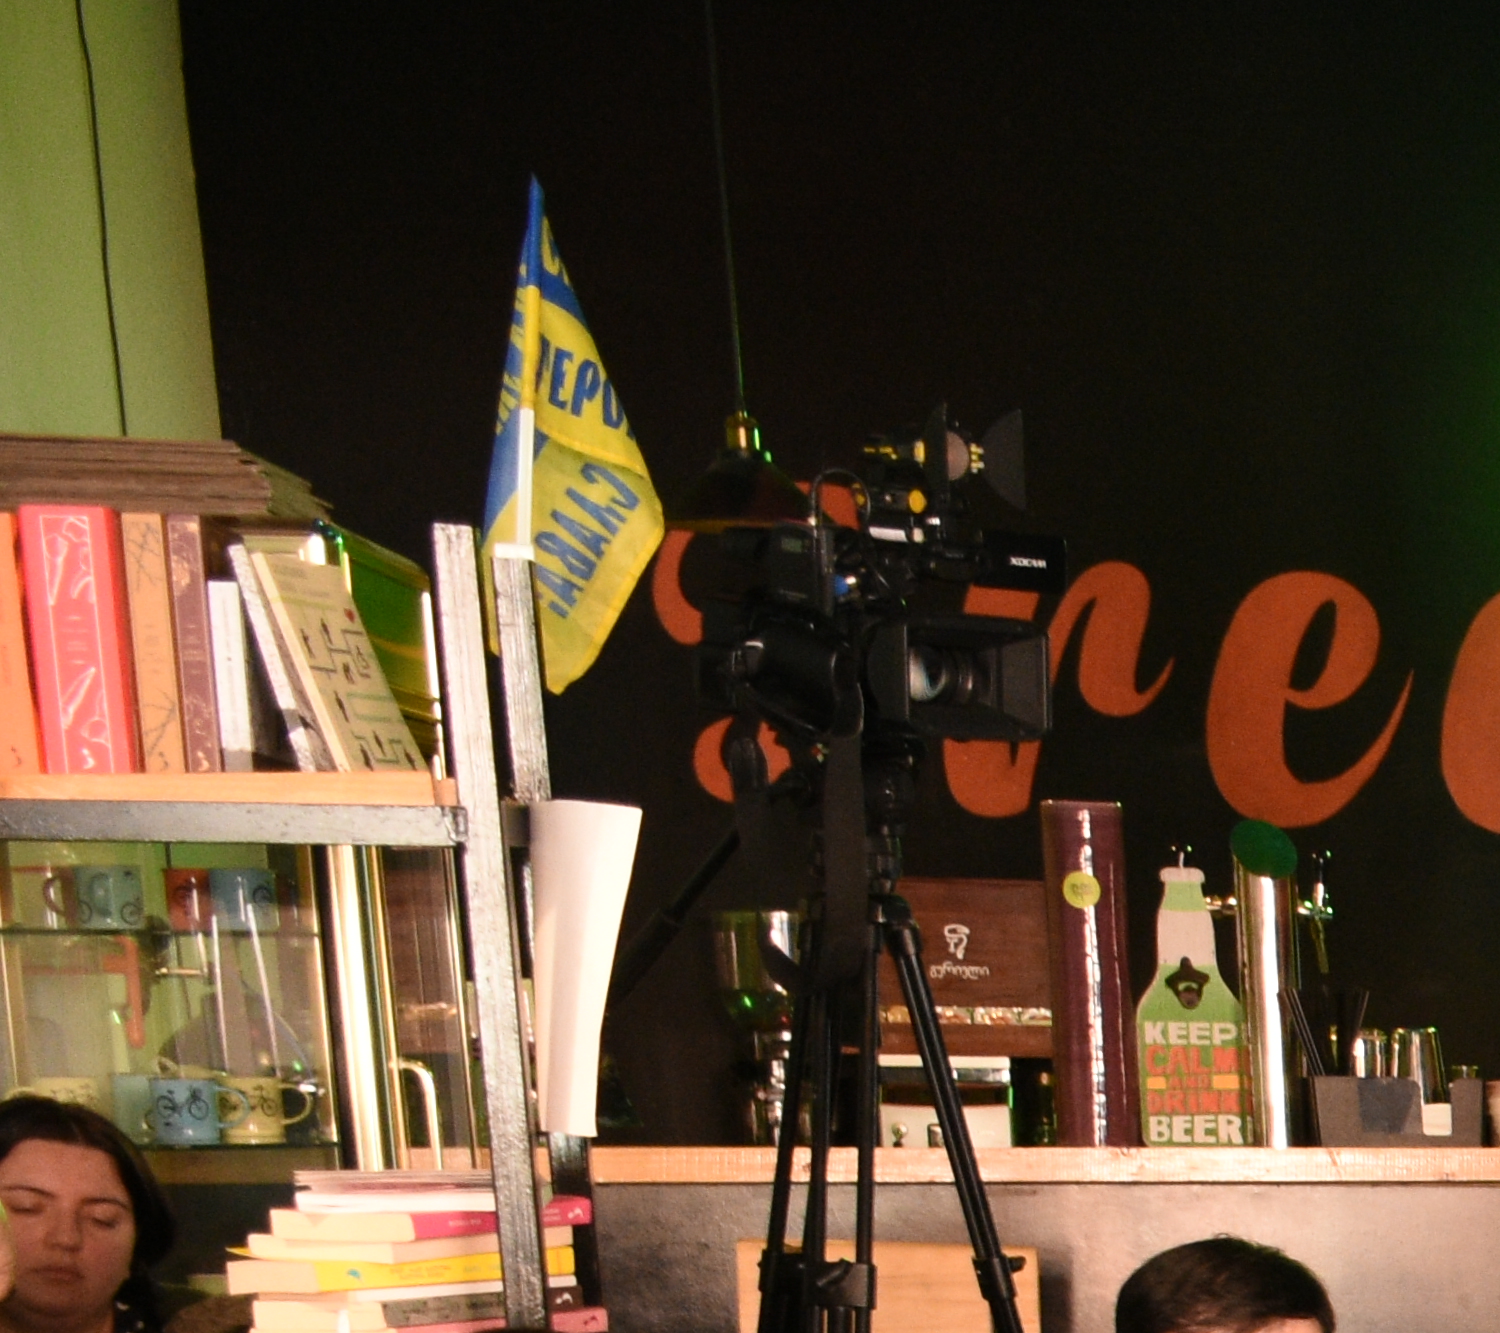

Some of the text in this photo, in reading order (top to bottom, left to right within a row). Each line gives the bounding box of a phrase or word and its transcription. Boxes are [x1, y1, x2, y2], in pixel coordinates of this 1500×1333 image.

[1143, 1020, 1238, 1046] KEEP
[1145, 1045, 1239, 1074] CALM
[1168, 1075, 1212, 1089] AND
[1146, 1089, 1240, 1115] DRINK
[1150, 1114, 1244, 1145] BEER
